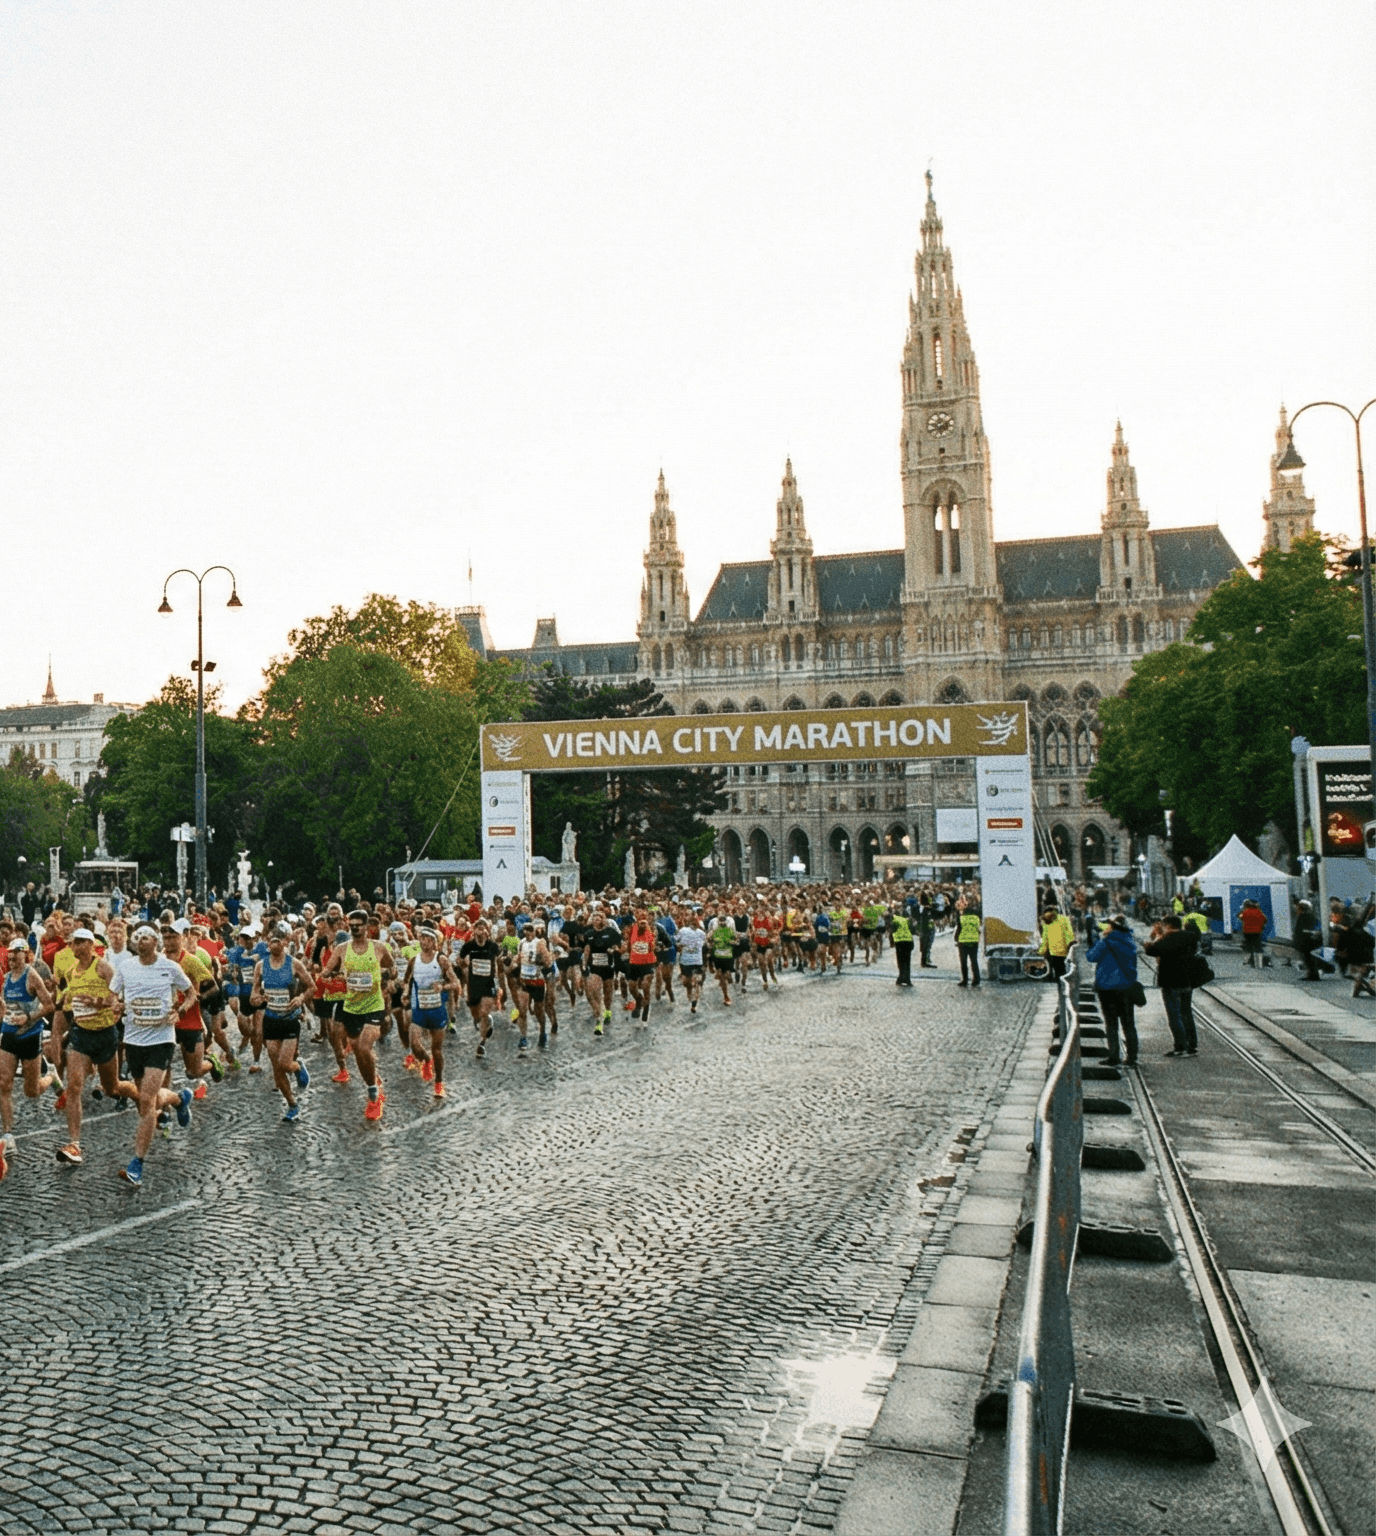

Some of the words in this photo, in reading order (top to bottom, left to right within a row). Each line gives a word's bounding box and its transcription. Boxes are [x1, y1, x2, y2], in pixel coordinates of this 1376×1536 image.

[542, 729, 663, 758] VIENNA
[672, 725, 745, 754] CITY
[754, 718, 952, 750] MARATHON
